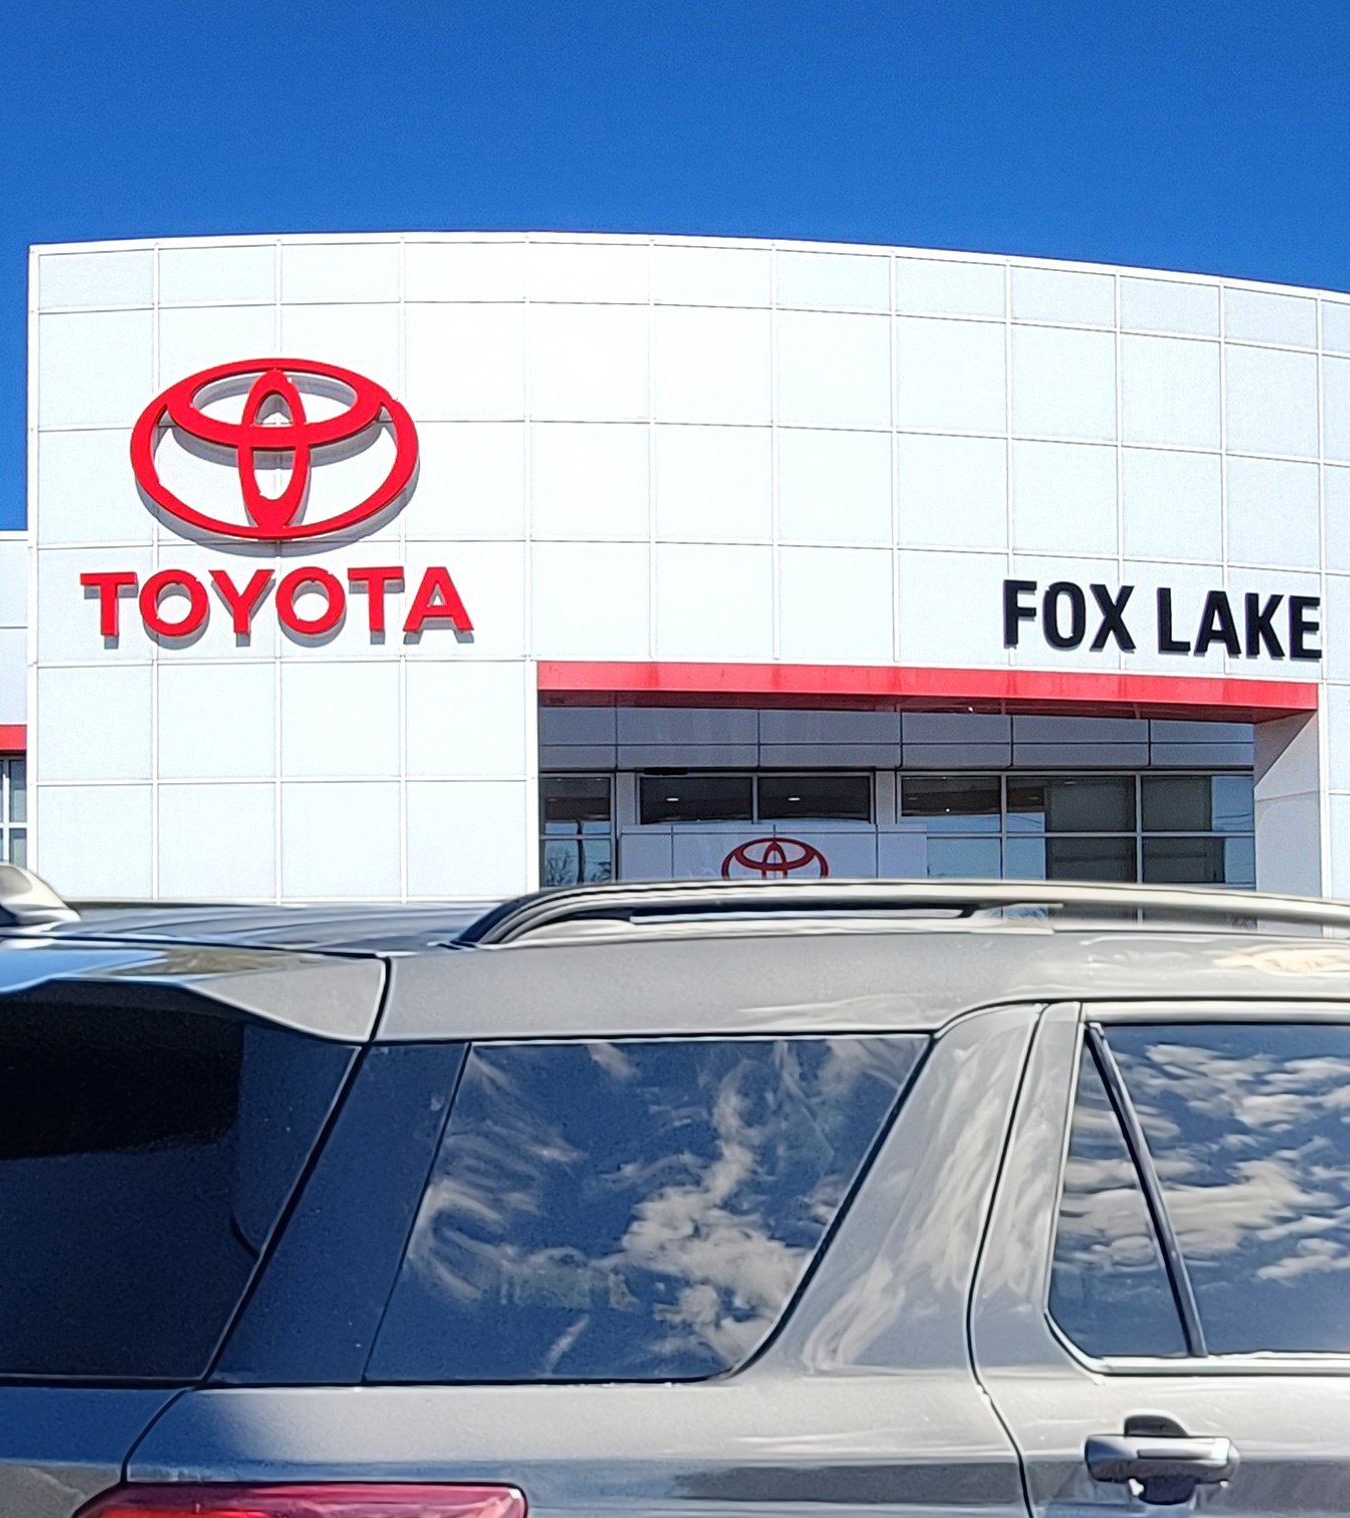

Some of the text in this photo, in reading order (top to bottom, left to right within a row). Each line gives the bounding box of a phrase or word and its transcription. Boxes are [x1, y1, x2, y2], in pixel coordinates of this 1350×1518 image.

[80, 566, 474, 637] TOYOTA
[1003, 579, 1323, 660] FOX LAKE
